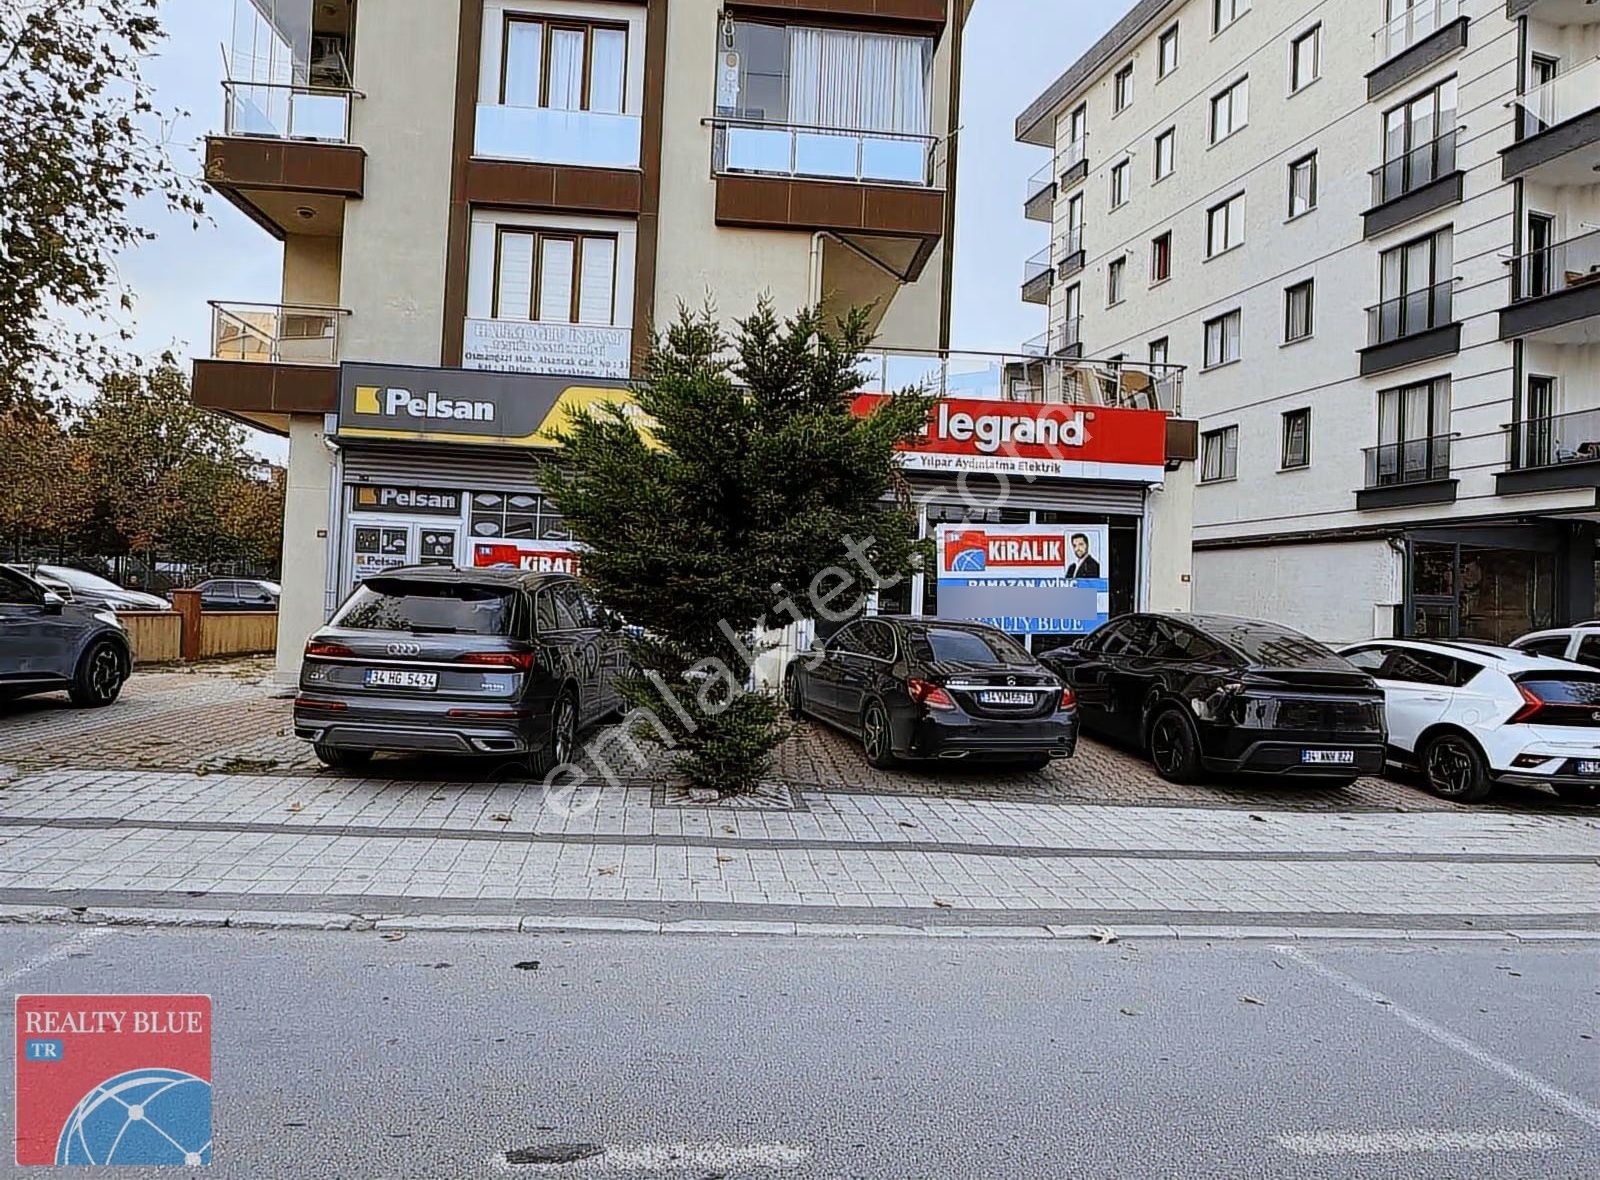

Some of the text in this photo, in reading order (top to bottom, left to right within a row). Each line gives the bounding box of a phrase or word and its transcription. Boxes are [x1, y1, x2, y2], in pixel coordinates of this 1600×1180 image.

[385, 388, 495, 422] Pelsan
[939, 404, 1084, 452] legrand
[955, 458, 1016, 471] Aydınlatma
[1018, 460, 1062, 474] Elektrik
[380, 488, 456, 509] Pelsan
[366, 556, 405, 567] Pelsan
[371, 670, 435, 686] 34 HG 5434
